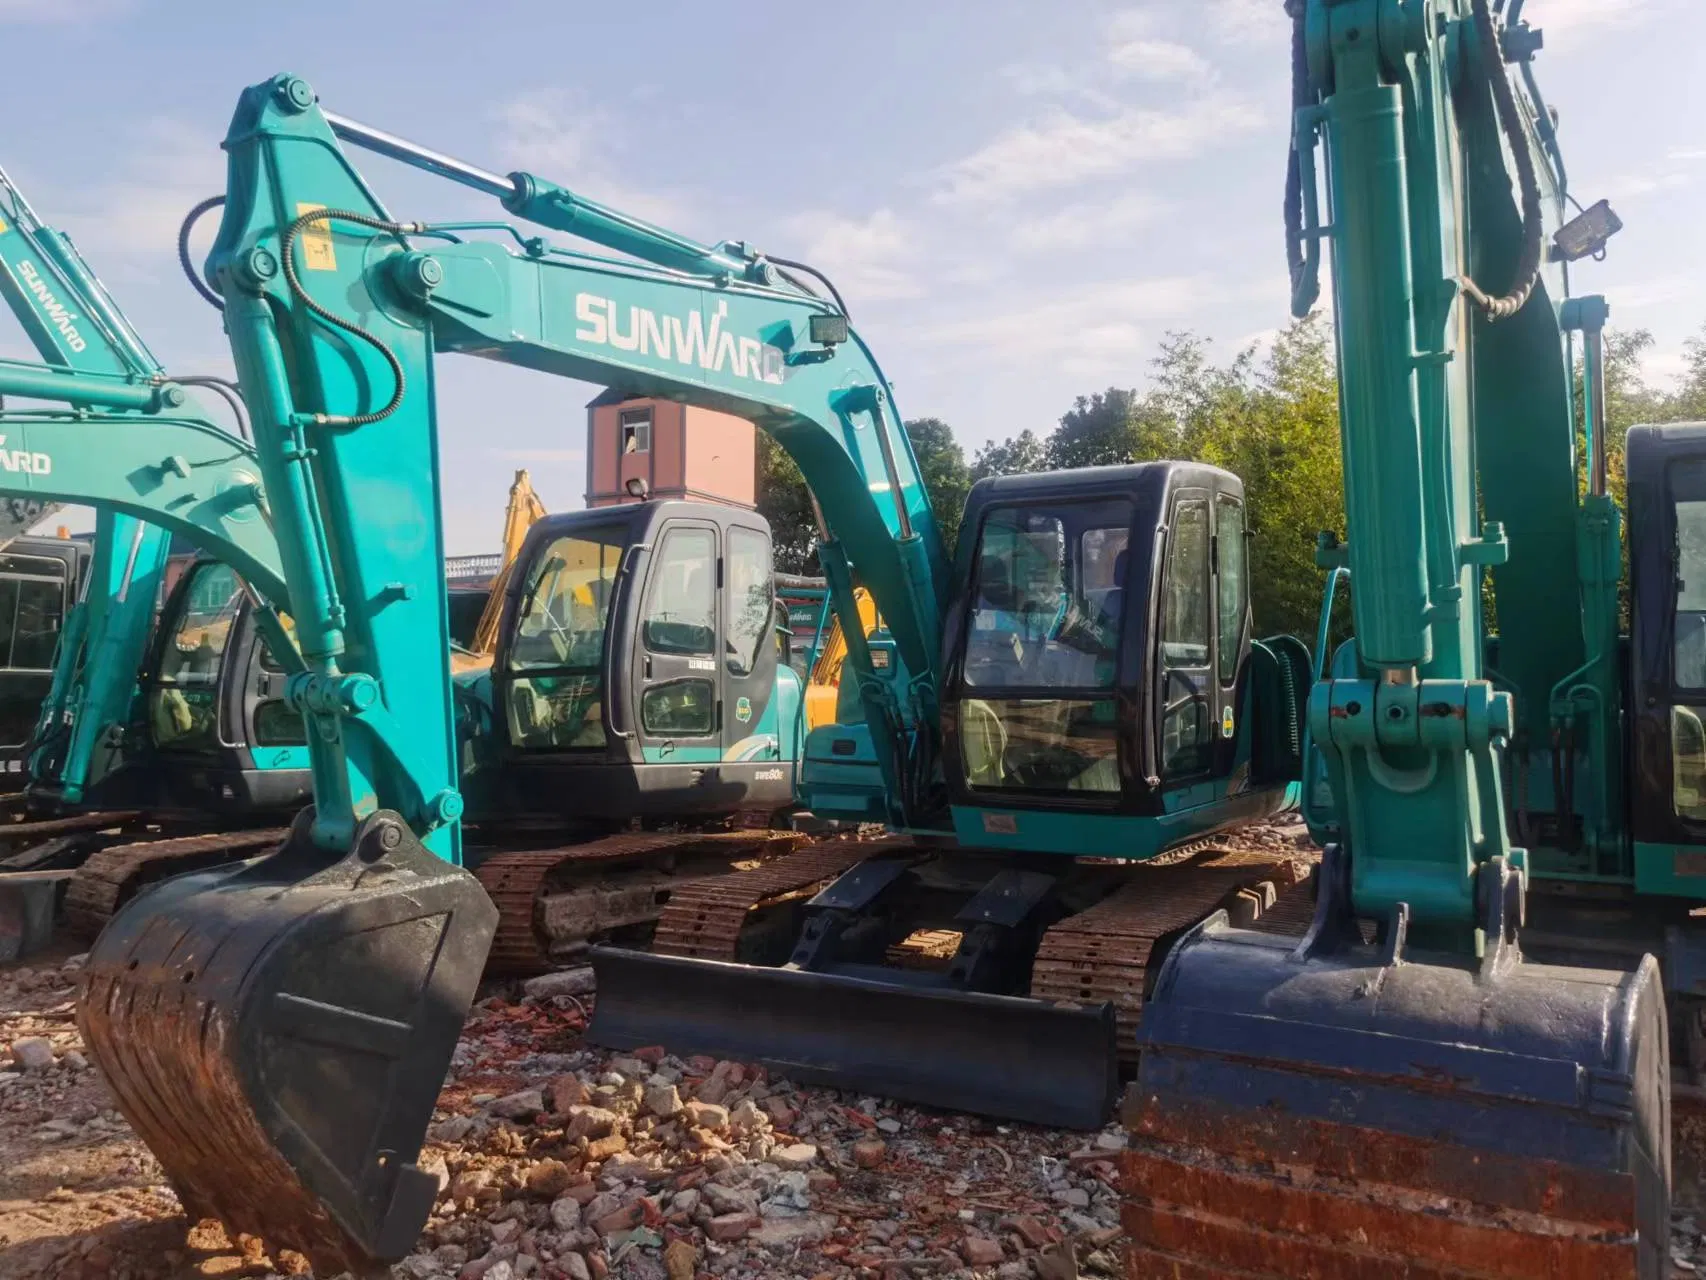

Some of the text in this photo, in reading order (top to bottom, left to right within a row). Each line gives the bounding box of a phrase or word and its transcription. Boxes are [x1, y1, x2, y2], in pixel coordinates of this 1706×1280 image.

[16, 260, 86, 353] SUNWARD
[575, 292, 784, 385] SUNWARD
[0, 435, 51, 474] ARD
